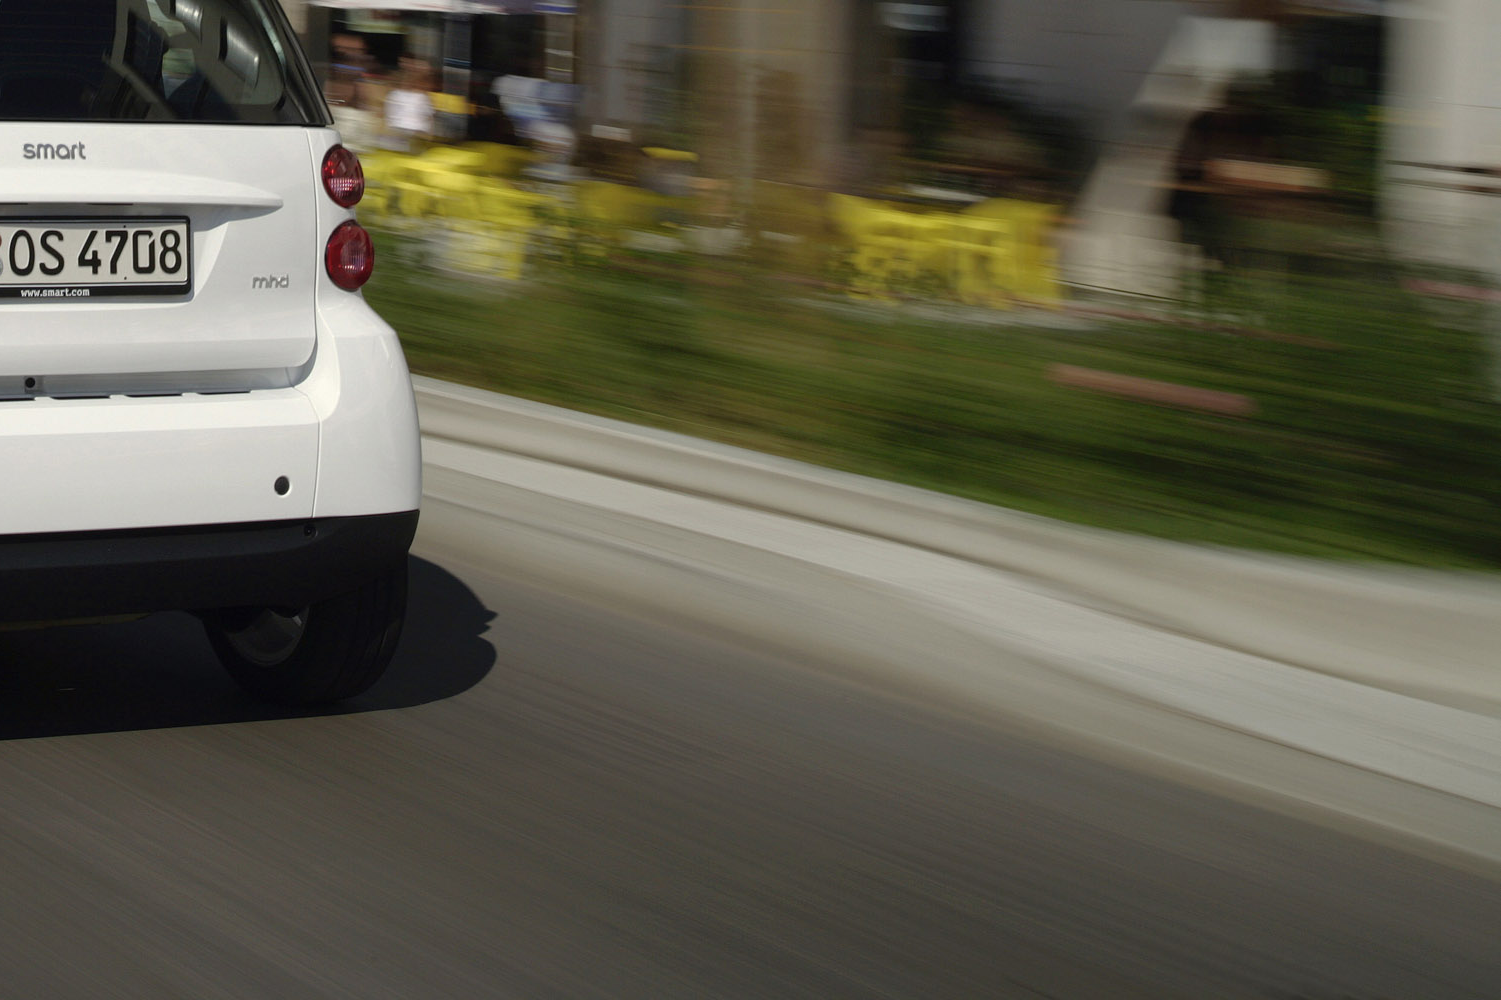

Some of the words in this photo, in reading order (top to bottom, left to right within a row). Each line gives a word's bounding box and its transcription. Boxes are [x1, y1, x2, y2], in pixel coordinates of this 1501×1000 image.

[23, 140, 86, 160] smart
[9, 230, 65, 276] OS
[78, 229, 182, 275] 4708
[252, 274, 289, 289] mhd
[20, 287, 90, 297] www.smart.com
